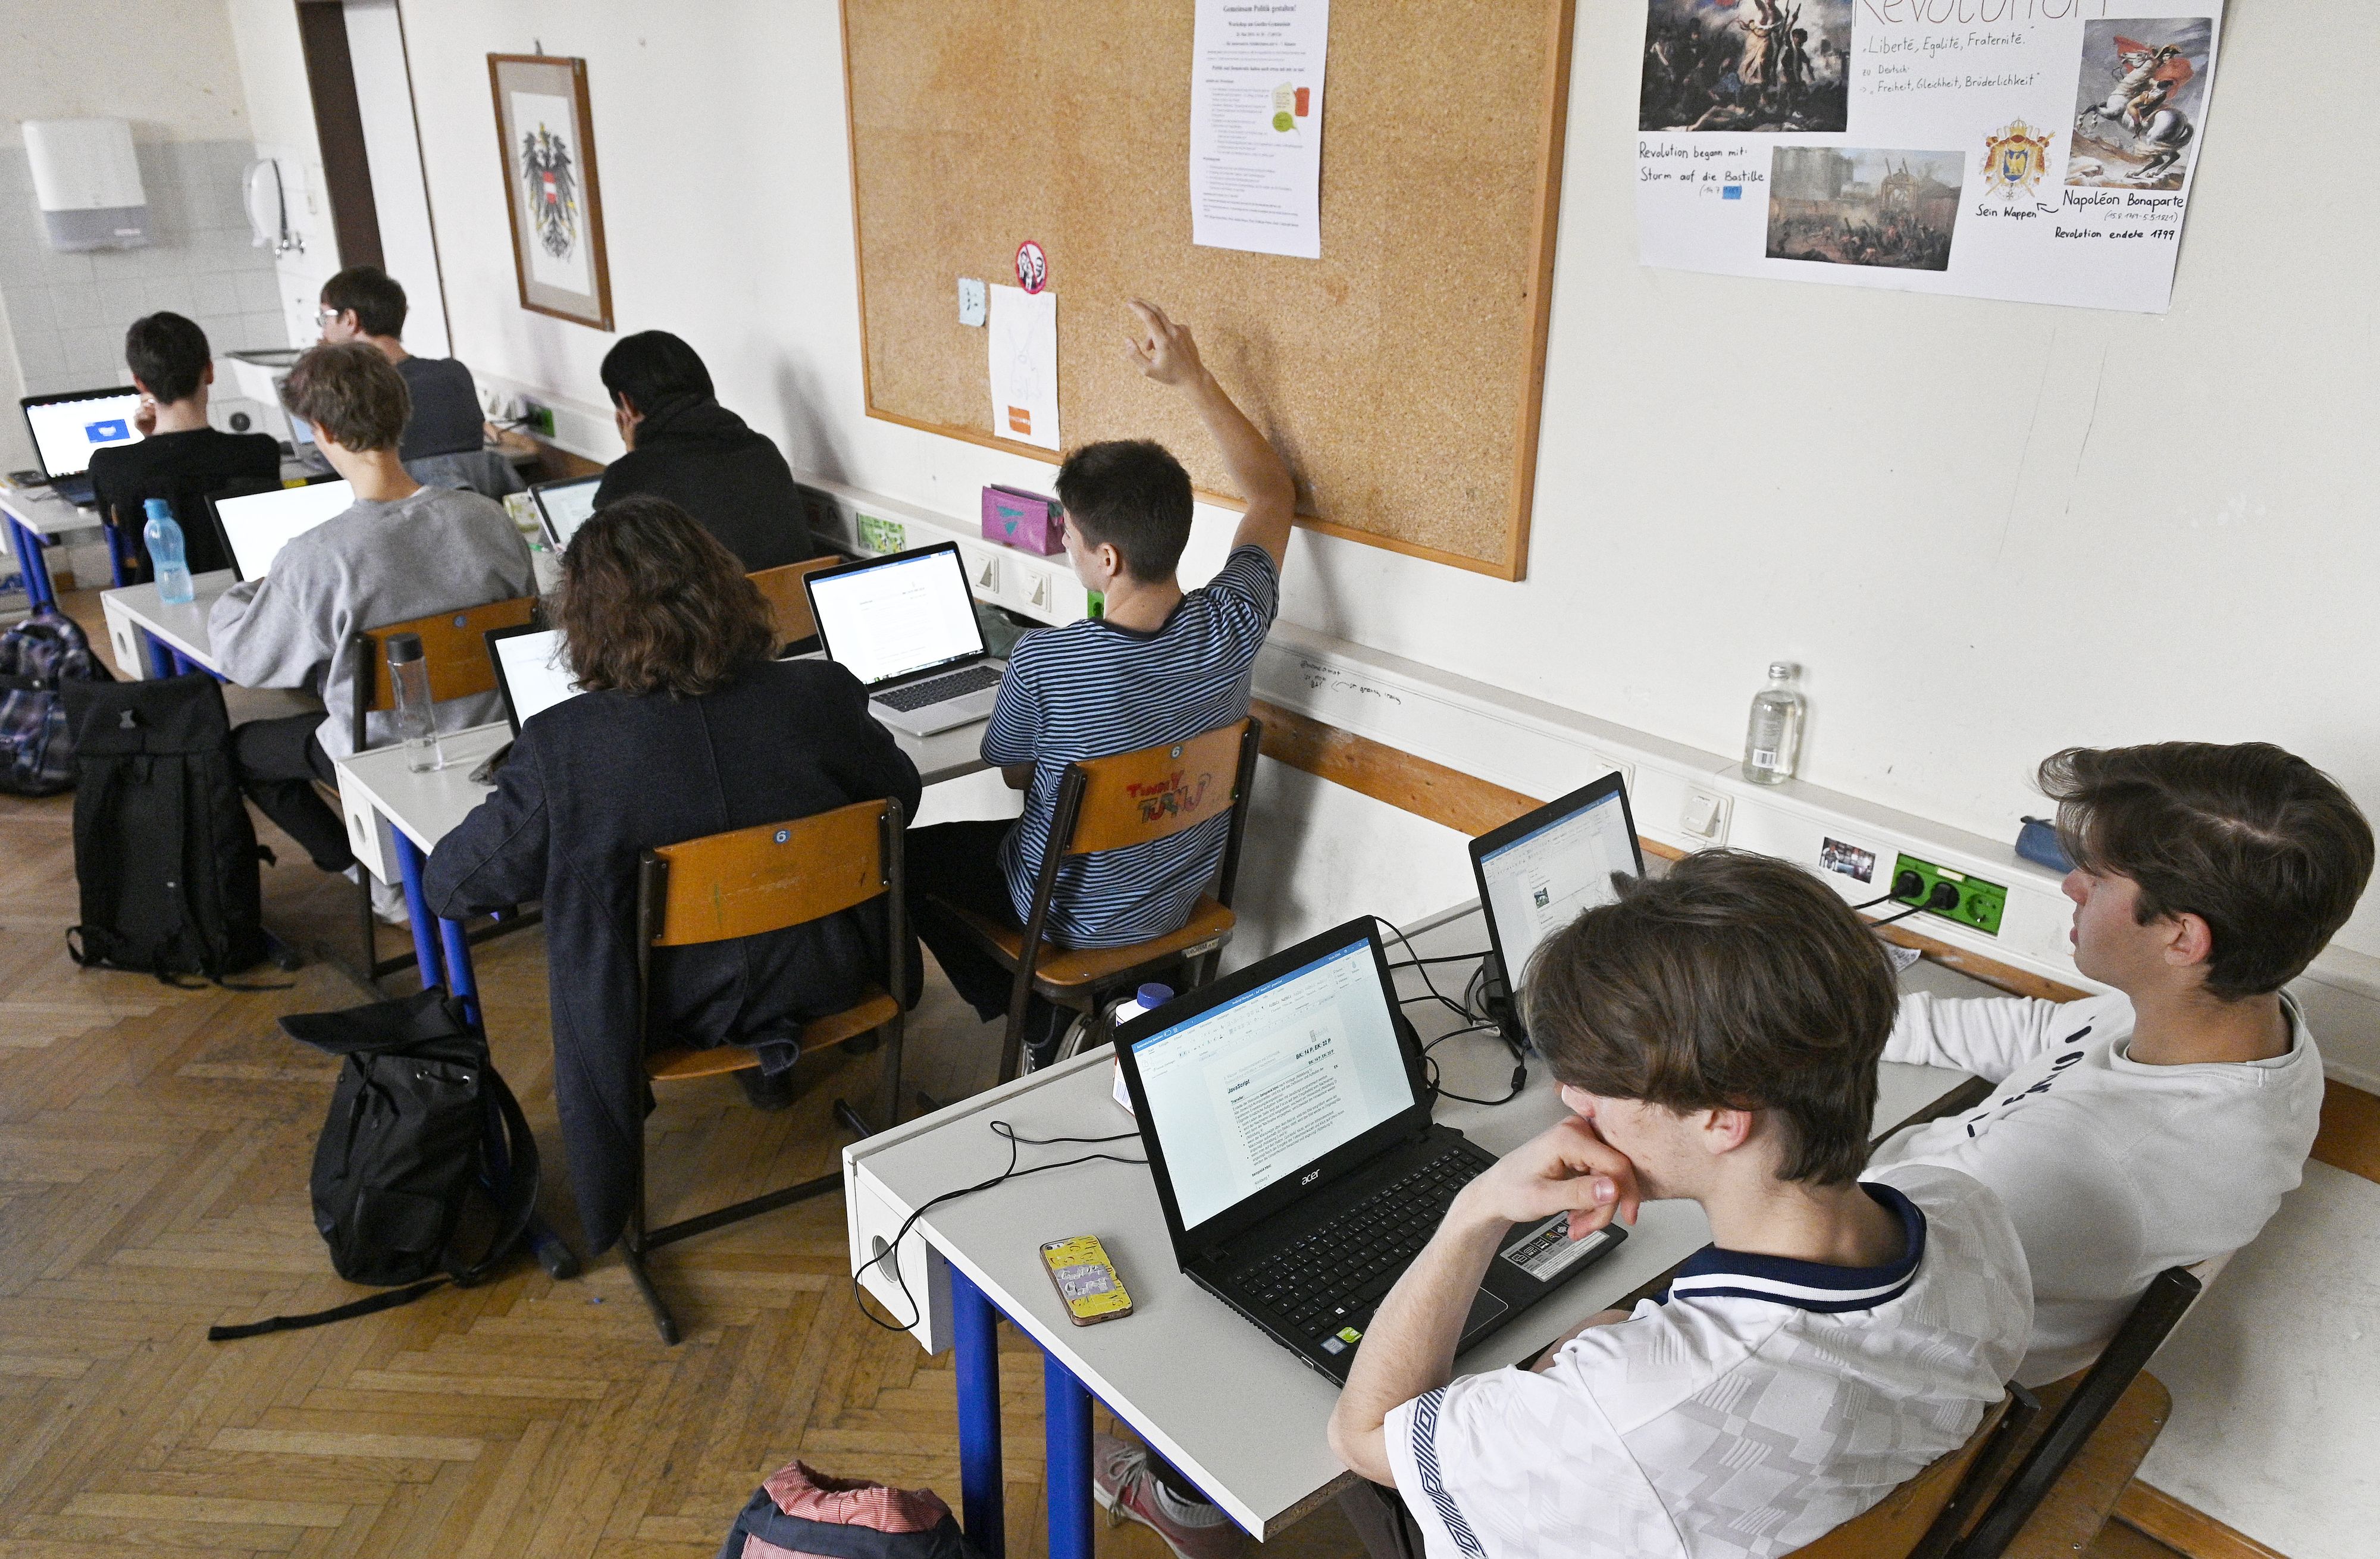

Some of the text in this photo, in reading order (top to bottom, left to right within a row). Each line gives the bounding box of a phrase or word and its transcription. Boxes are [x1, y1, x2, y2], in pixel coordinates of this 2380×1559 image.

[1639, 141, 1689, 159] Revolution
[1693, 145, 1723, 161] begann
[1640, 166, 1765, 183] Sturm auf die Bastille
[2062, 189, 2184, 212] Napoléon Bonaparte
[1975, 204, 2037, 221] Sein Wappen
[2055, 226, 2175, 240] Revolution endete 1799
[776, 830, 787, 842] 6
[1227, 1079, 1250, 1094] JavaScript
[1301, 1168, 1321, 1186] acer
